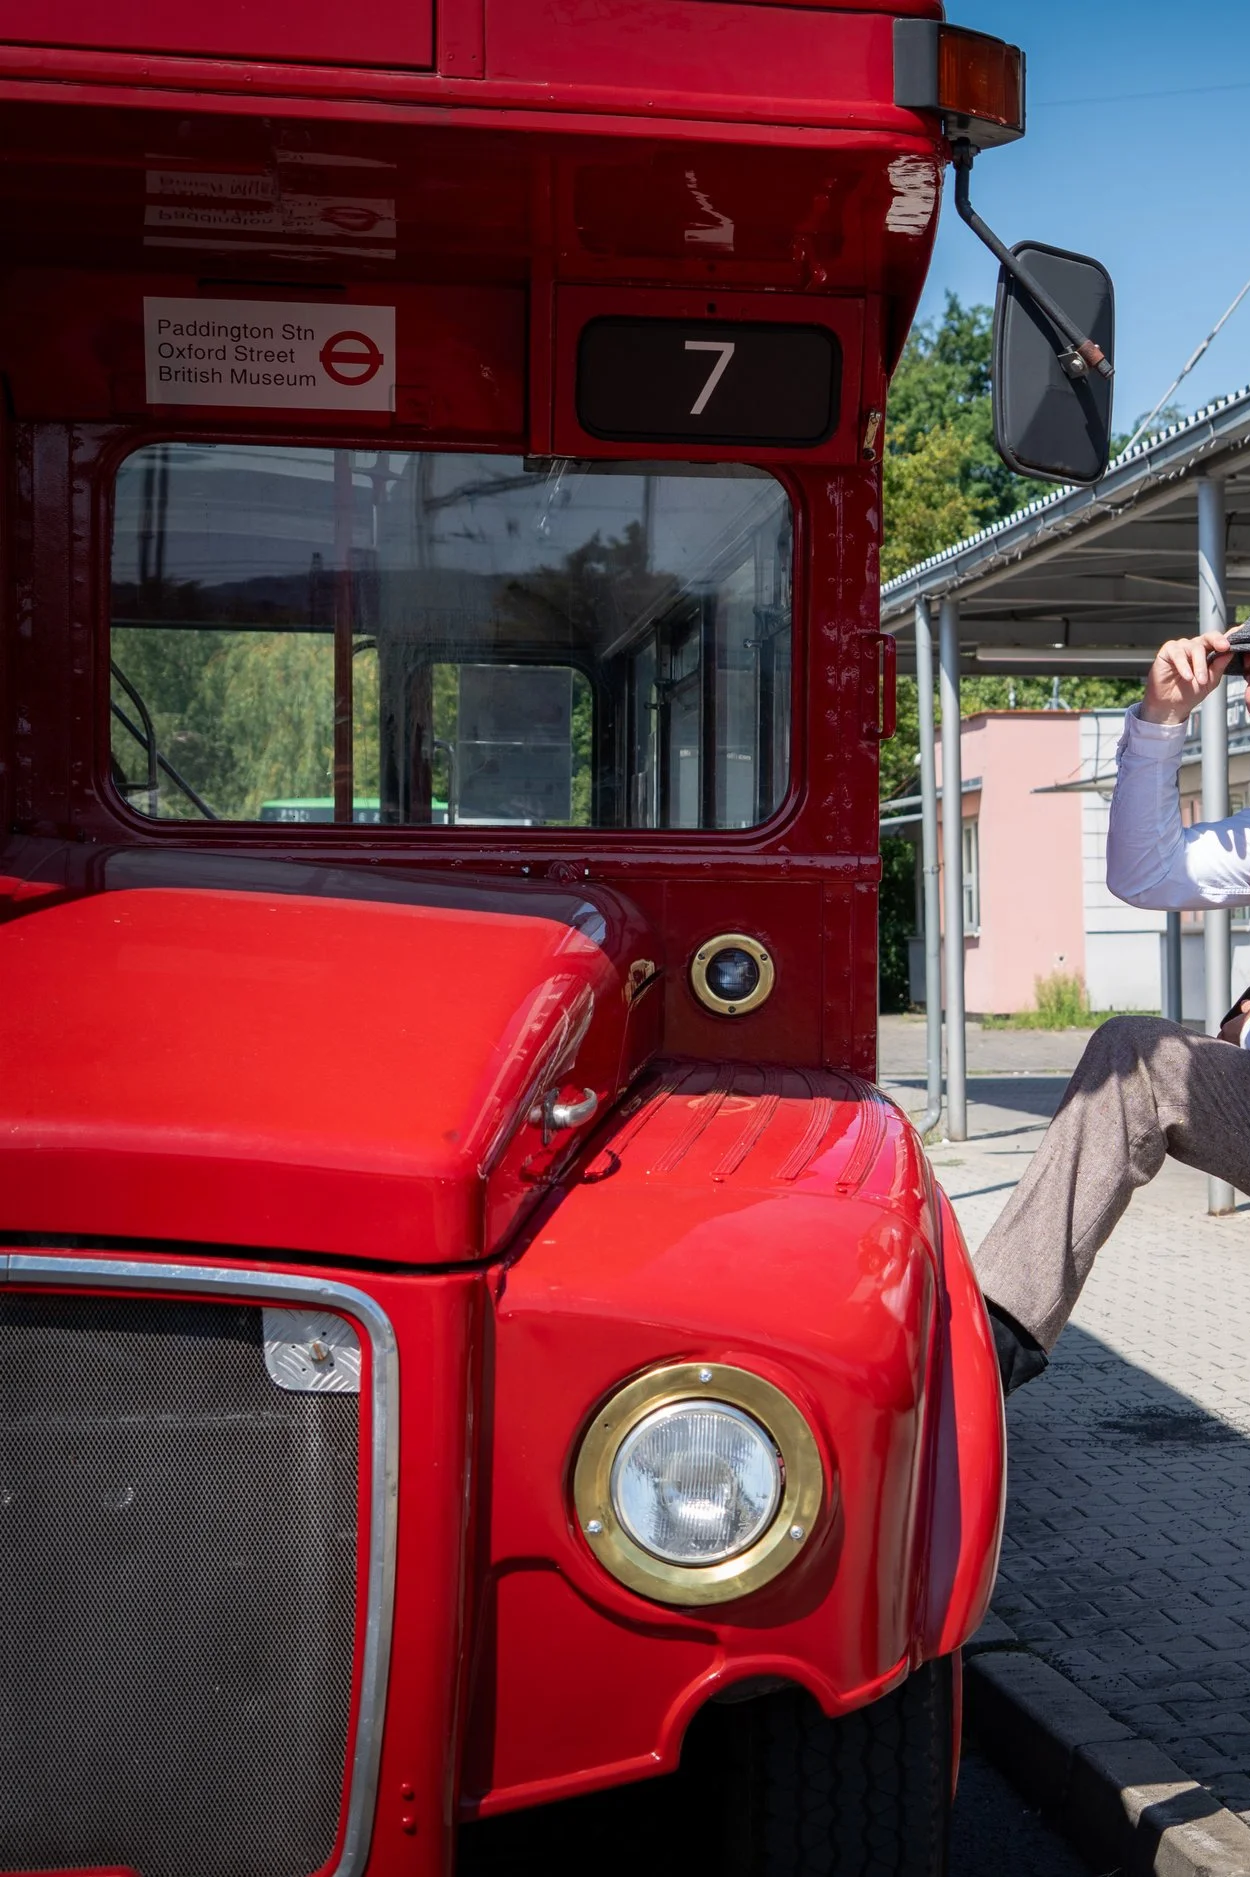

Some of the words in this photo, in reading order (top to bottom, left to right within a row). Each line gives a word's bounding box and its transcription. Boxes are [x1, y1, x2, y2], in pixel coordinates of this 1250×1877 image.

[157, 319, 274, 342] Paddington
[281, 324, 315, 341] Stn
[157, 342, 227, 361] Oxford
[234, 345, 296, 363] Street
[158, 365, 223, 383] British
[230, 368, 316, 387] Museum
[685, 341, 735, 415] 7
